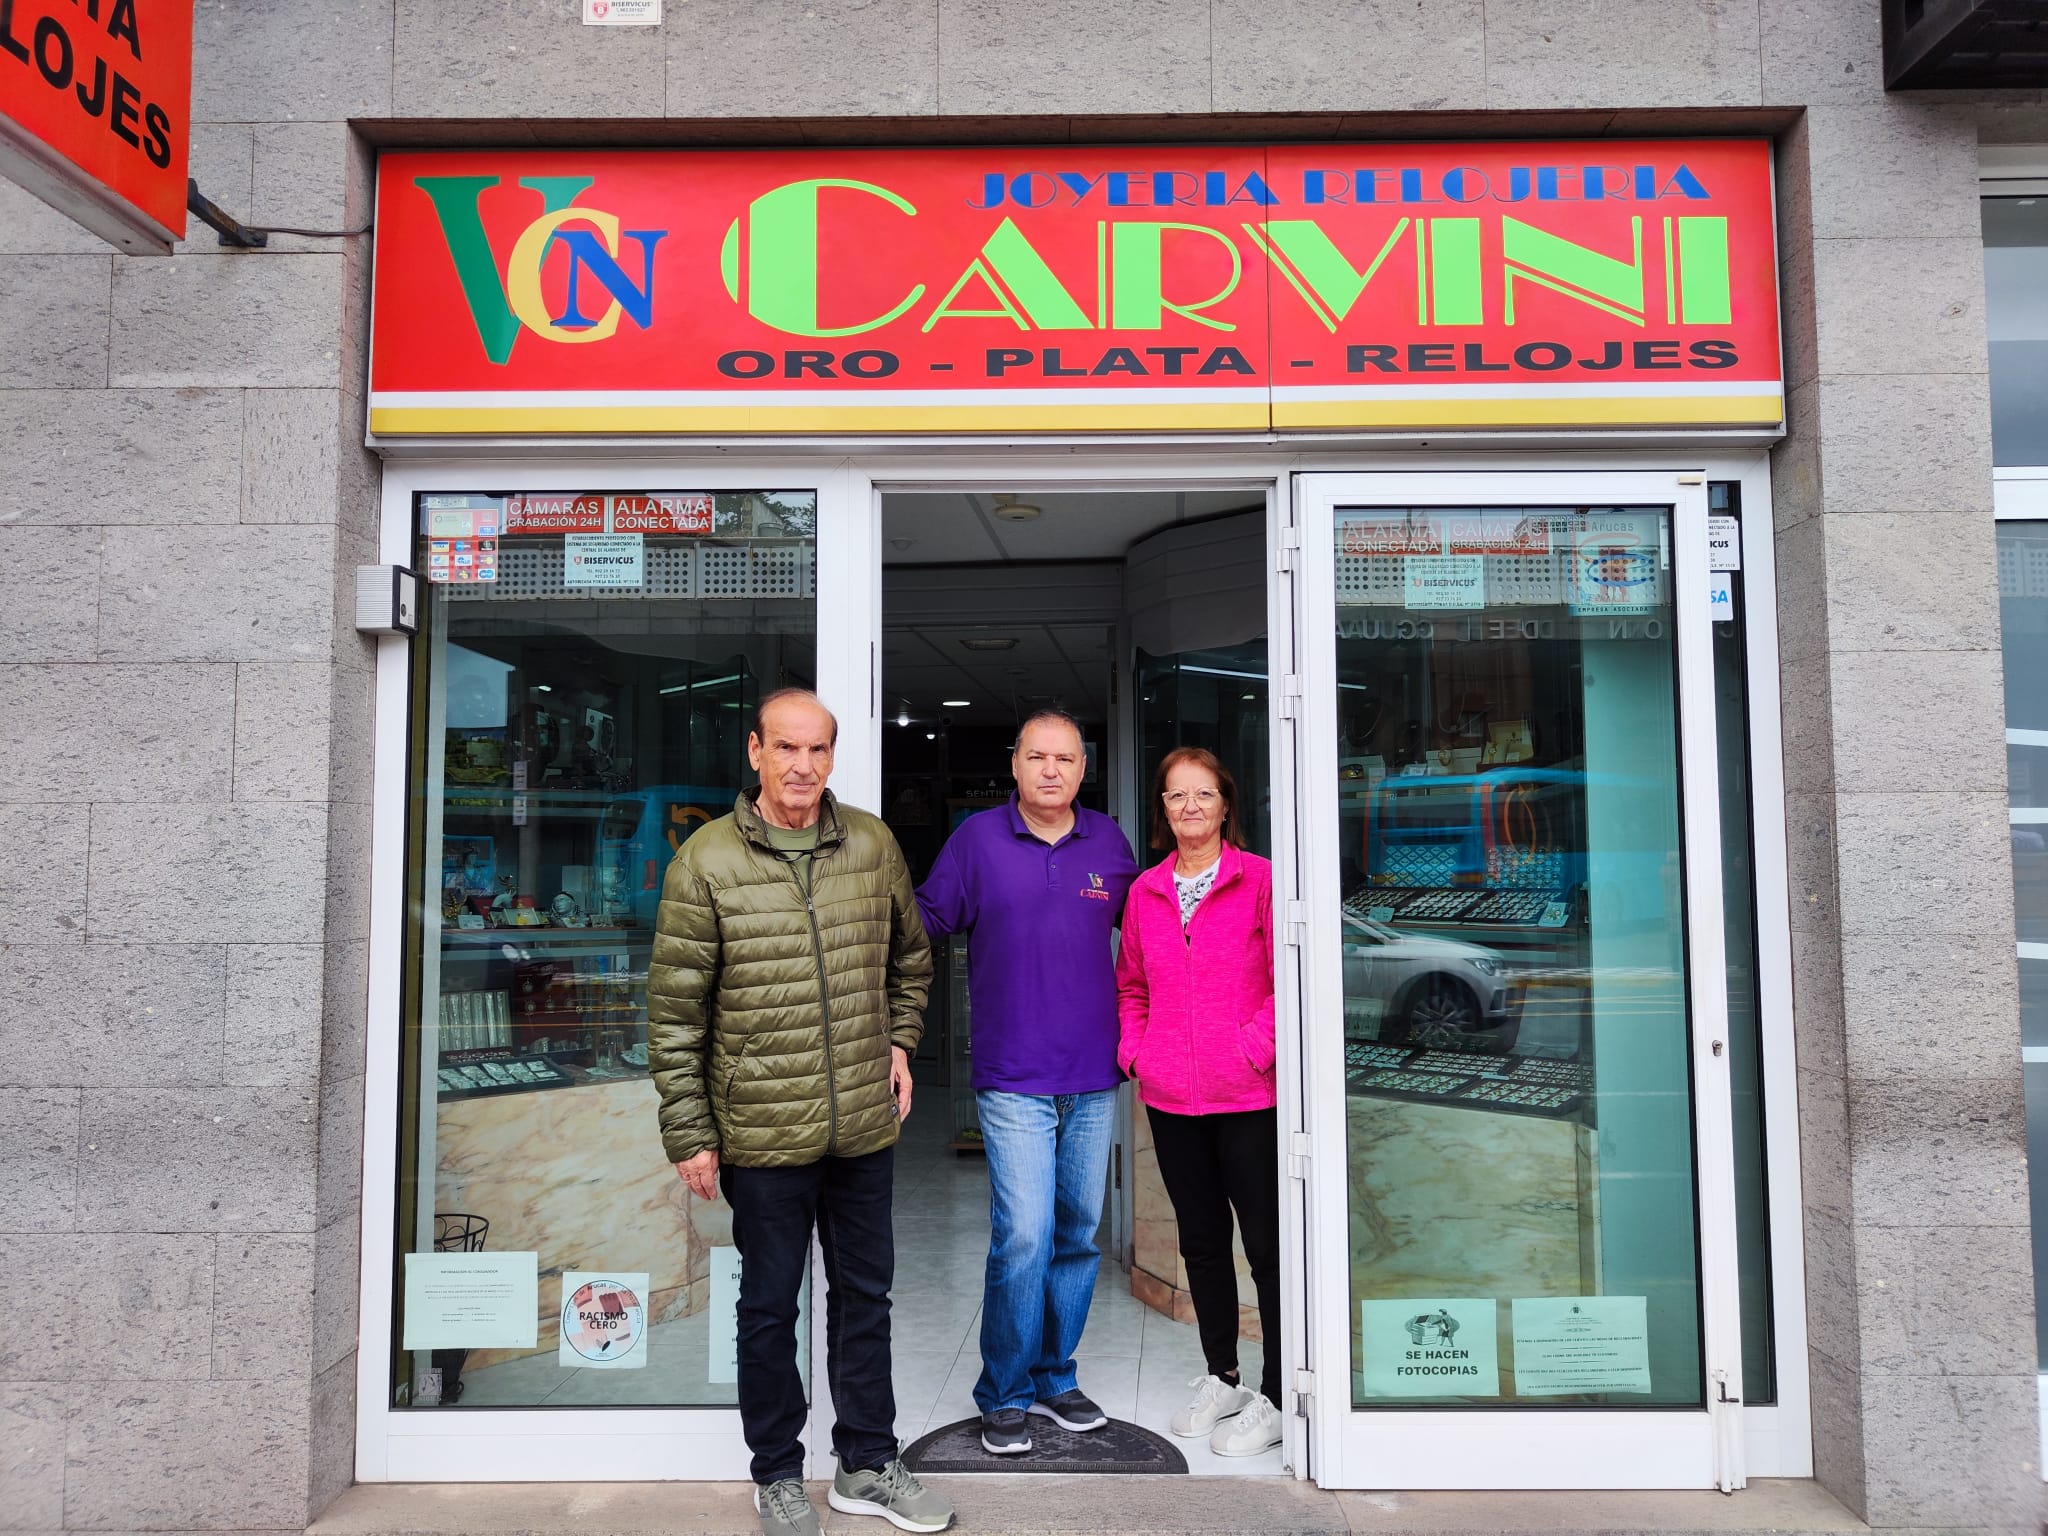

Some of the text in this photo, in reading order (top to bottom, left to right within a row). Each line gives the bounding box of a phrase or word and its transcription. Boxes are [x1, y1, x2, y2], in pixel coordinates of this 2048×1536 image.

[966, 163, 1711, 209] JOYERIA RELOJERIA
[720, 177, 1732, 338] CARVINI
[716, 349, 900, 378] ORO
[985, 346, 1257, 377] PLATA
[1346, 340, 1740, 373] RELOJES
[509, 499, 599, 515] CÁMARAS
[616, 499, 707, 514] ALARMA
[508, 515, 601, 527] GRABACIÓN 24H
[615, 516, 709, 529] CONECTADA
[1591, 521, 1634, 532] Arucas
[1346, 523, 1438, 538] ALARMA
[1344, 540, 1440, 552] CONECTADA
[1524, 540, 1546, 549] 24H
[584, 556, 634, 564] BISERVICUS
[1424, 579, 1475, 587] BISERVICUS
[579, 1311, 628, 1321] RACISMO
[589, 1320, 618, 1330] CERO
[1406, 1350, 1469, 1359] SE HACEN
[1397, 1366, 1478, 1376] FOTOCOPIAS
